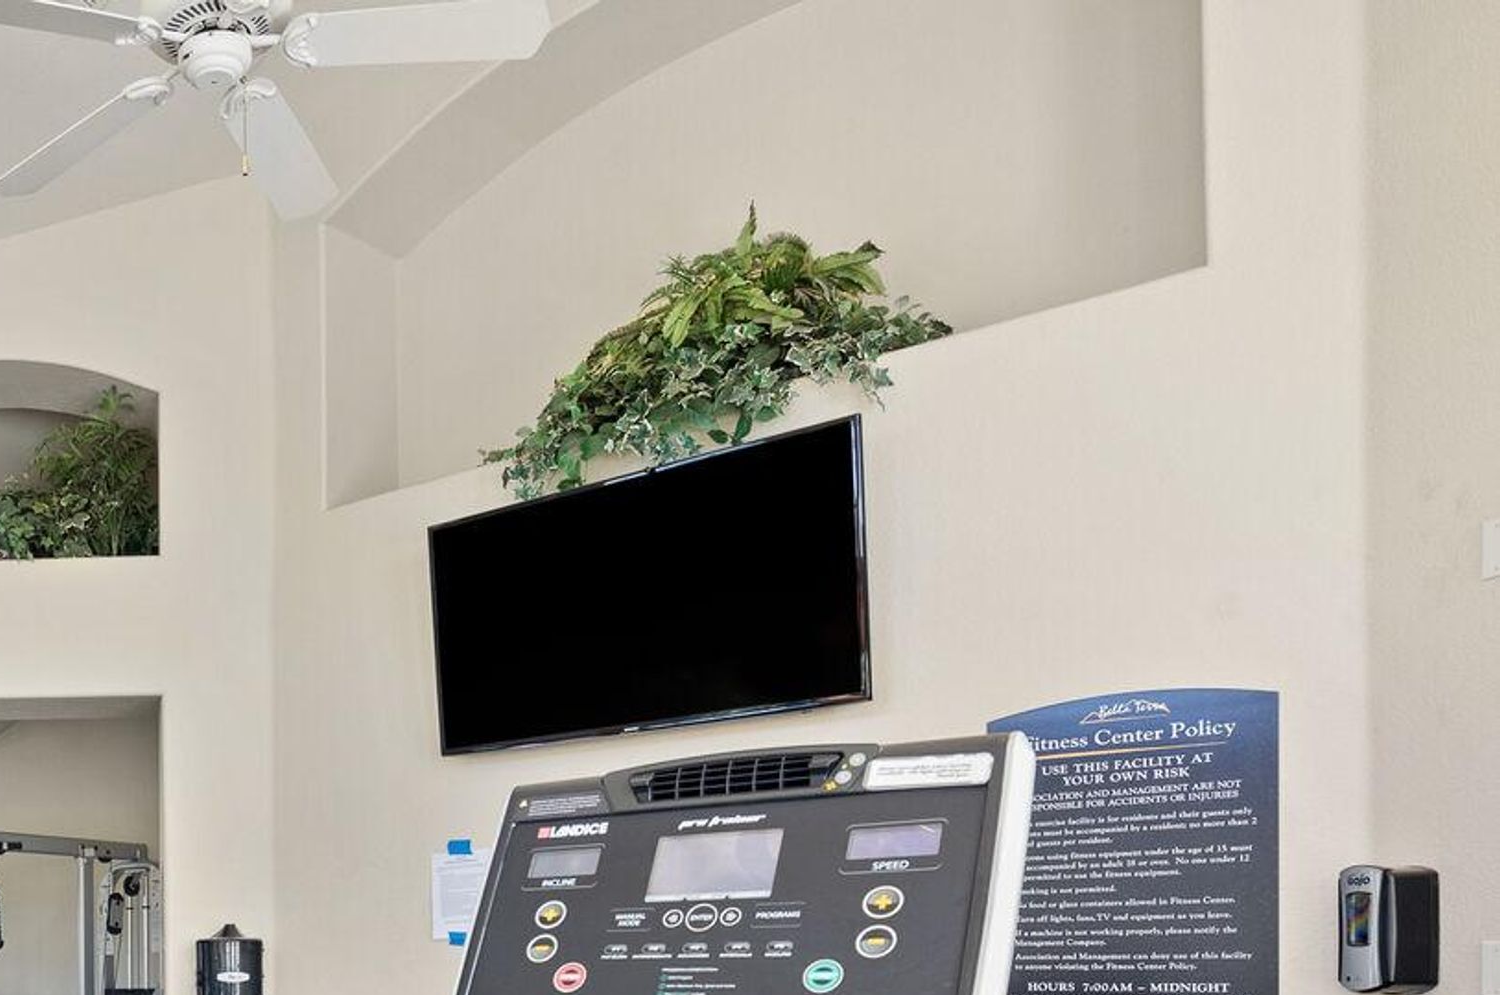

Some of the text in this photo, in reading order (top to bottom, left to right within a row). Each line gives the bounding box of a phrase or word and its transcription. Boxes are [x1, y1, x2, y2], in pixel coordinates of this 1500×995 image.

[1095, 729, 1163, 746] Center
[1171, 719, 1236, 738] Policy
[1042, 752, 1213, 776] USE THIS FACILITY AT
[1063, 766, 1189, 786] YOUR OWN RISK
[1034, 780, 1241, 801] OCIATION AND MANAGEMENT ARE NOT
[1030, 790, 1239, 811] SPONSIBLE FOR ACCIDENTS OR INJURIES
[1179, 810, 1199, 819] their
[1202, 810, 1229, 819] guests
[550, 822, 609, 839] LANDICE
[1076, 825, 1128, 834] accompanied
[1130, 825, 1140, 833] by
[1228, 818, 1248, 826] than
[1252, 817, 1257, 825] 2
[1063, 839, 1075, 847] per
[1099, 850, 1141, 859] equipment
[1145, 847, 1169, 855] under
[1172, 846, 1185, 854] the
[1205, 845, 1213, 853] of
[872, 859, 909, 872] SPEED
[1078, 861, 1087, 869] by
[1103, 859, 1122, 868] adult
[1209, 855, 1235, 863] under
[1090, 870, 1102, 878] the
[1105, 869, 1132, 877] fitness
[1135, 868, 1182, 878] equipment.
[541, 878, 577, 887] INCLINE
[1075, 884, 1116, 895] permitted.
[1060, 900, 1078, 909] glass
[1125, 898, 1156, 906] allowed
[1170, 897, 1200, 905] Fitness
[1203, 895, 1235, 904] Center.
[755, 910, 800, 920] PROGRAMS
[1037, 914, 1047, 922] off
[1096, 913, 1110, 921] TV
[1113, 913, 1128, 921] and
[1130, 913, 1174, 921] equipment
[1189, 913, 1204, 921] you
[1031, 928, 1062, 936] machine
[1090, 927, 1123, 937] working
[1166, 926, 1190, 935] please
[1194, 925, 1219, 935] notify
[1223, 925, 1236, 933] the
[1067, 938, 1106, 947] Company.
[1079, 953, 1130, 961] Management
[1202, 951, 1218, 959] this
[1221, 951, 1252, 960] facility
[1092, 962, 1103, 970] the
[1107, 962, 1134, 970] Fitness
[1137, 962, 1166, 970] Center
[1169, 961, 1197, 971] Policy.
[1028, 982, 1075, 992] HOURS
[1083, 982, 1133, 992] 7:00AM
[1150, 982, 1230, 993] MIDNIGHT
